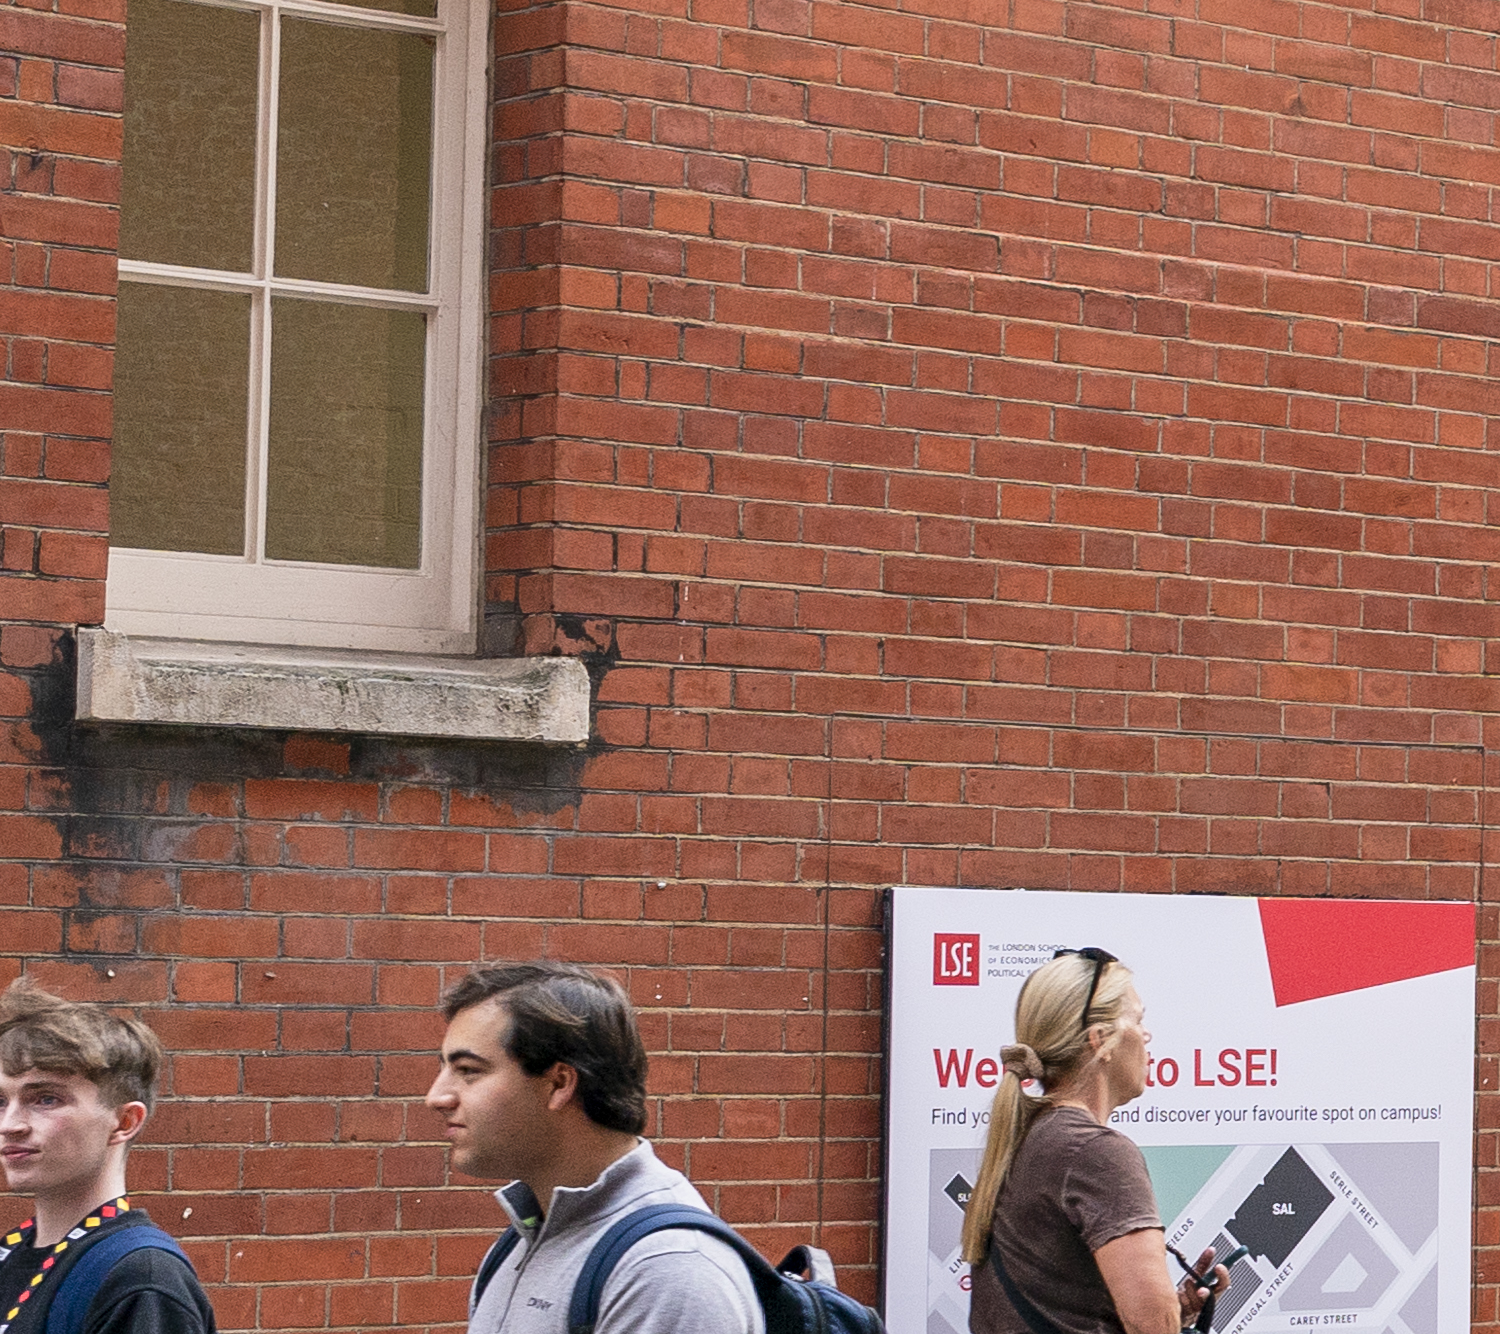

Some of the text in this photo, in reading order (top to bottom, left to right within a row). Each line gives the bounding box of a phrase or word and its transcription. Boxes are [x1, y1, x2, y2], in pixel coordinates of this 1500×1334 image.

[988, 944, 1000, 952] THE
[1002, 944, 1036, 952] LONDON
[940, 942, 973, 977] LSE
[988, 969, 1026, 978] POLITICAL
[1146, 1048, 1279, 1088] to LSE!
[932, 1108, 967, 1125] Find
[1111, 1107, 1140, 1123] and
[1145, 1106, 1210, 1123] discover
[1214, 1109, 1248, 1126] your
[1252, 1105, 1318, 1123] favourite
[1322, 1106, 1354, 1125] spot
[1358, 1109, 1376, 1121] on
[1380, 1104, 1442, 1124] campus!
[1272, 1202, 1296, 1215] SAL
[1329, 1170, 1380, 1230] SERLE STREET
[1265, 1262, 1295, 1298] STREET
[1289, 1313, 1358, 1326] CAREY STREET
